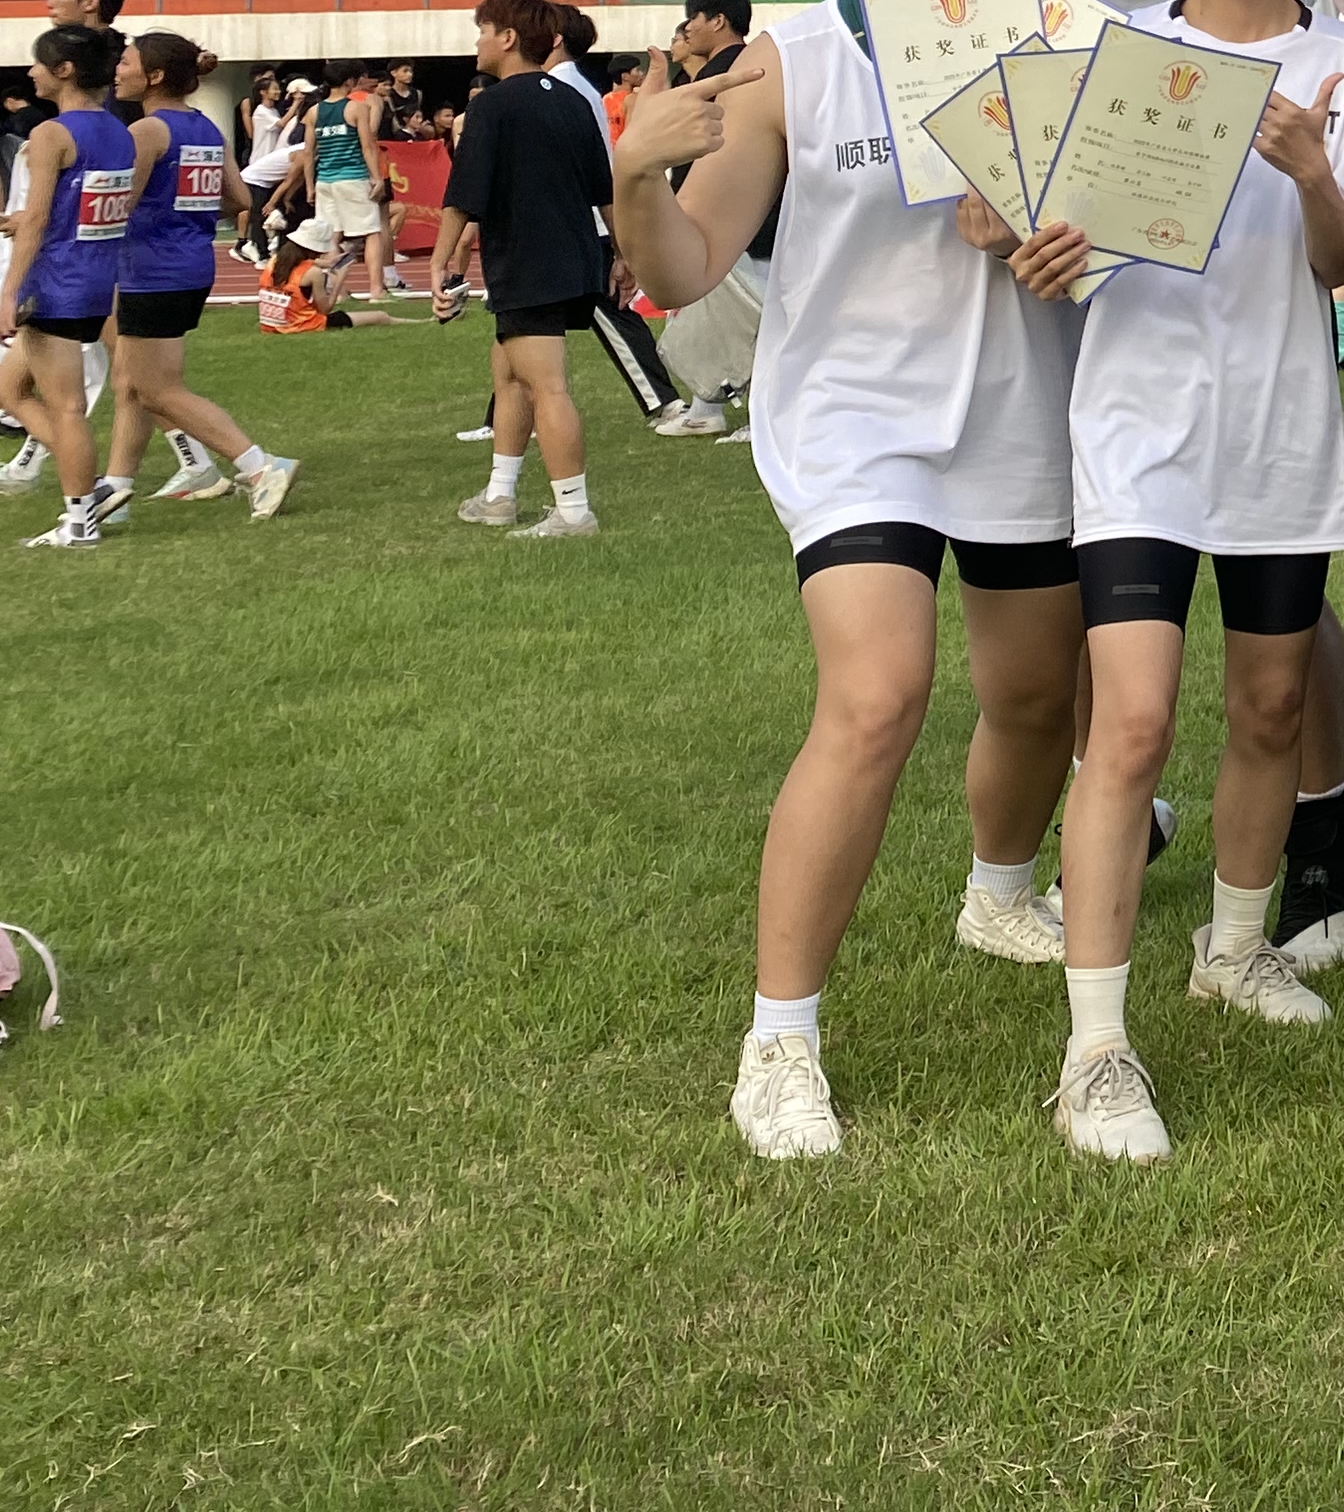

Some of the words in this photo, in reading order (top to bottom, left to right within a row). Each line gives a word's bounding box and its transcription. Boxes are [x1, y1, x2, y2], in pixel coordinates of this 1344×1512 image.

[903, 26, 1020, 64] 获奖证书
[1107, 97, 1229, 140] 获奖证书
